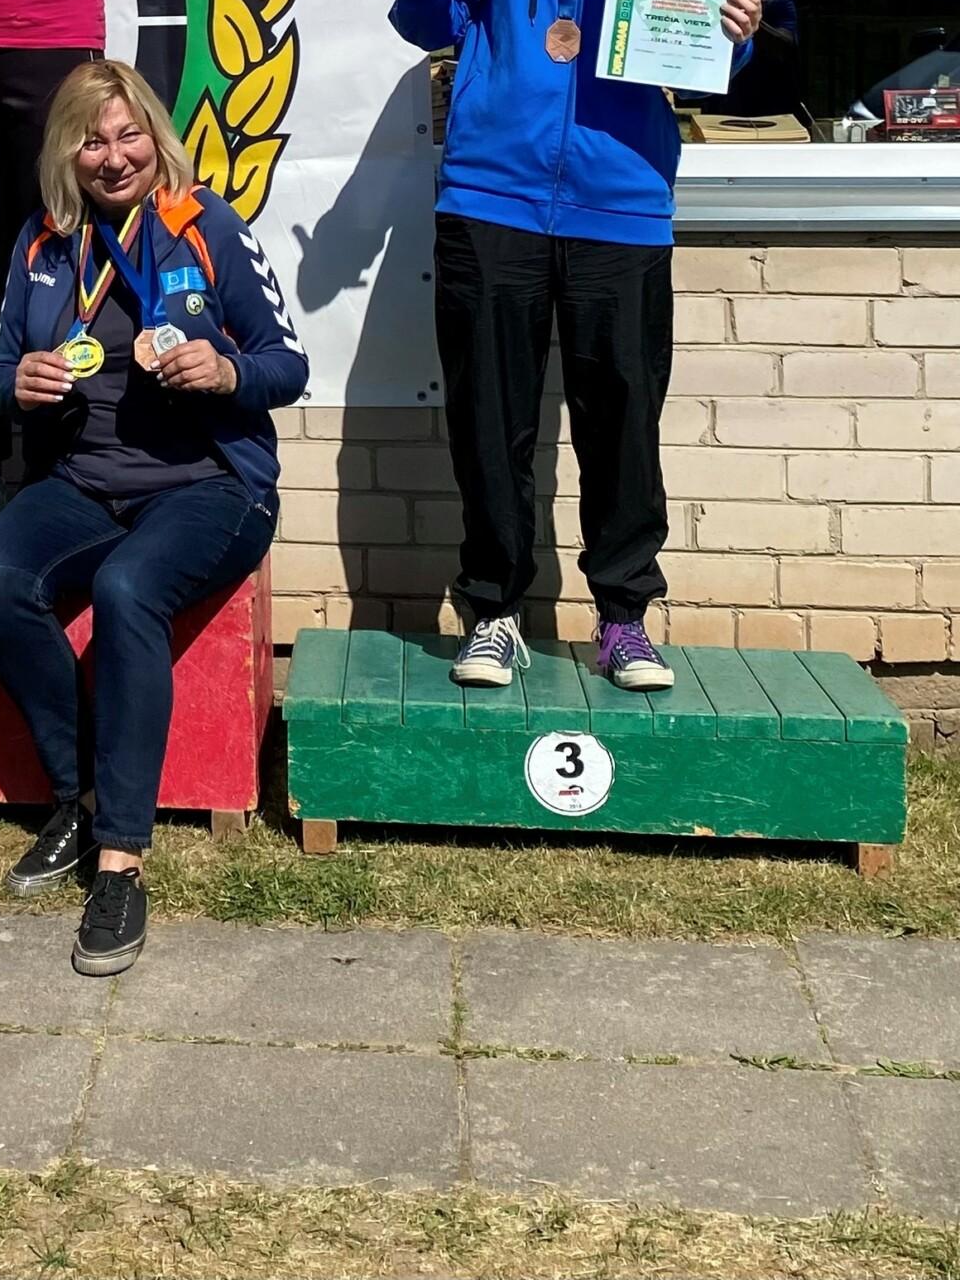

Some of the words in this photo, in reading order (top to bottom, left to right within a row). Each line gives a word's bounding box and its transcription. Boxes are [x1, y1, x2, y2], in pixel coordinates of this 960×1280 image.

[645, 14, 680, 24] TREČIA
[683, 18, 712, 27] VIETA
[612, 21, 629, 75] DIPLOMAS
[554, 742, 585, 778] 3
